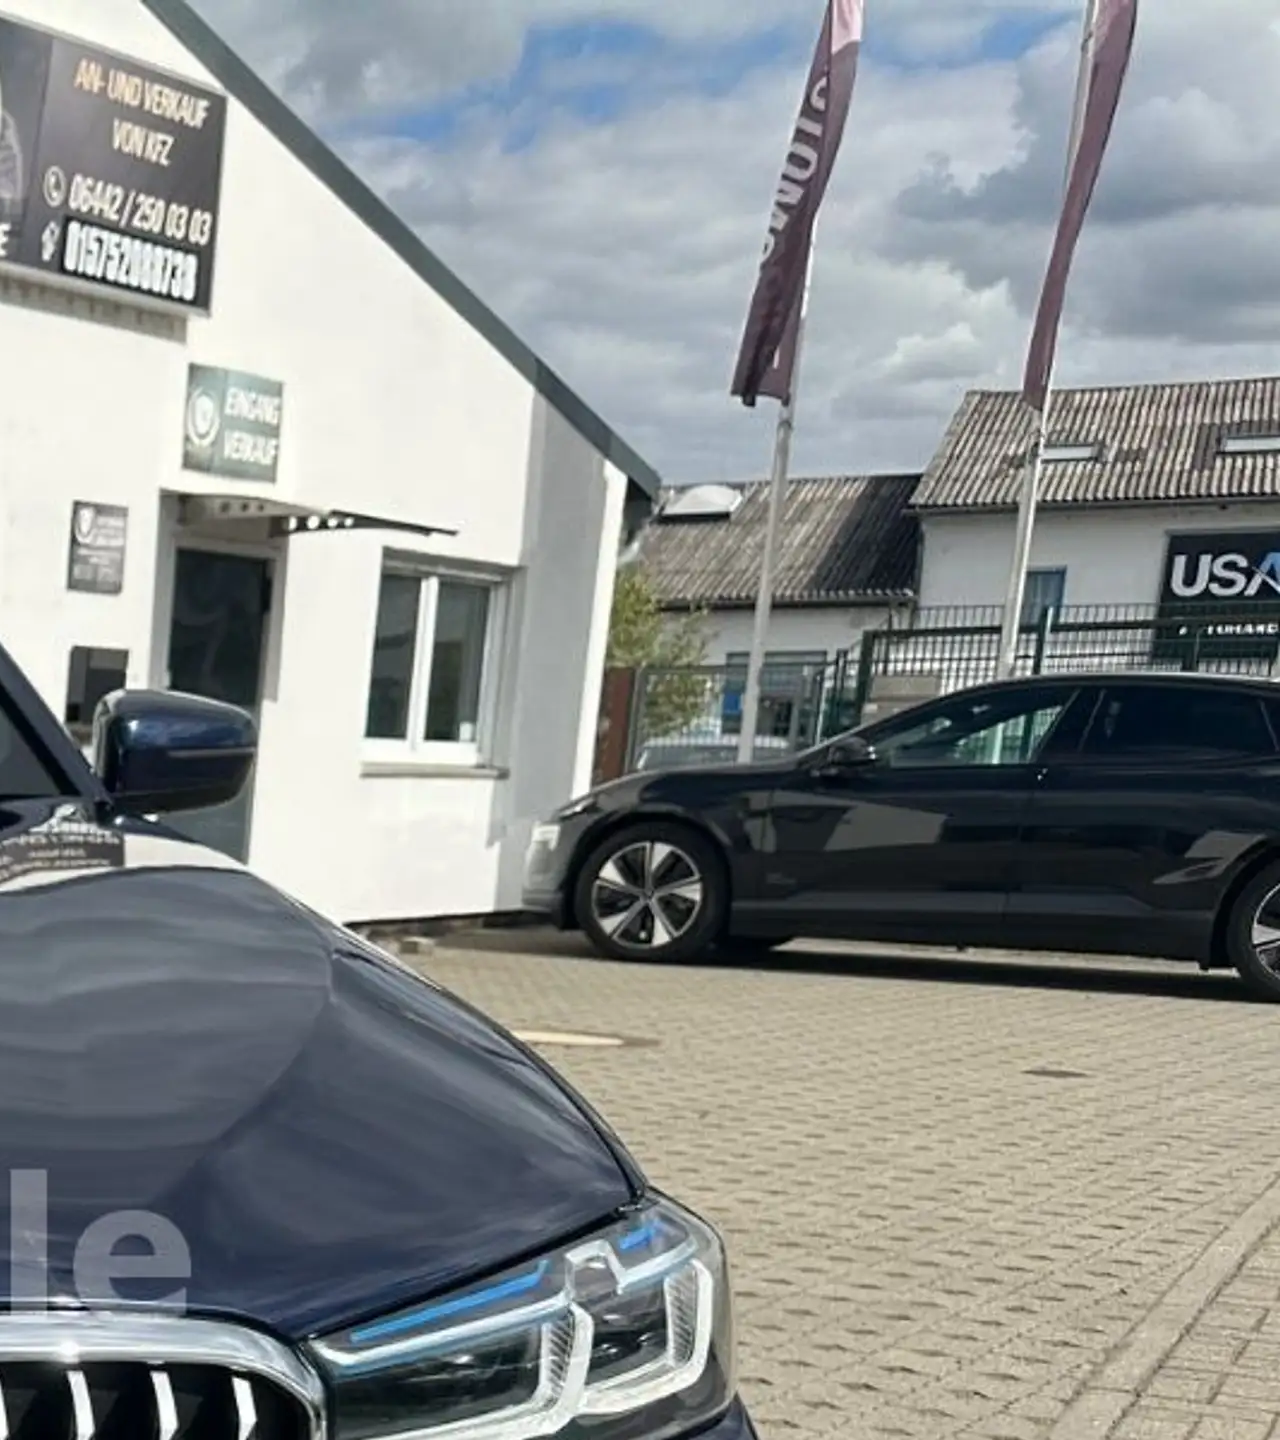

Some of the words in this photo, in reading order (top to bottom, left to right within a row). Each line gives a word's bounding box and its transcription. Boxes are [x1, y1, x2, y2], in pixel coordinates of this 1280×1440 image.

[107, 68, 142, 107] UND
[145, 81, 210, 128] VERKAUF
[113, 118, 146, 158] VON
[68, 173, 124, 220] 06442
[131, 193, 166, 234] 250
[165, 203, 189, 240] 03
[188, 209, 212, 246] 03
